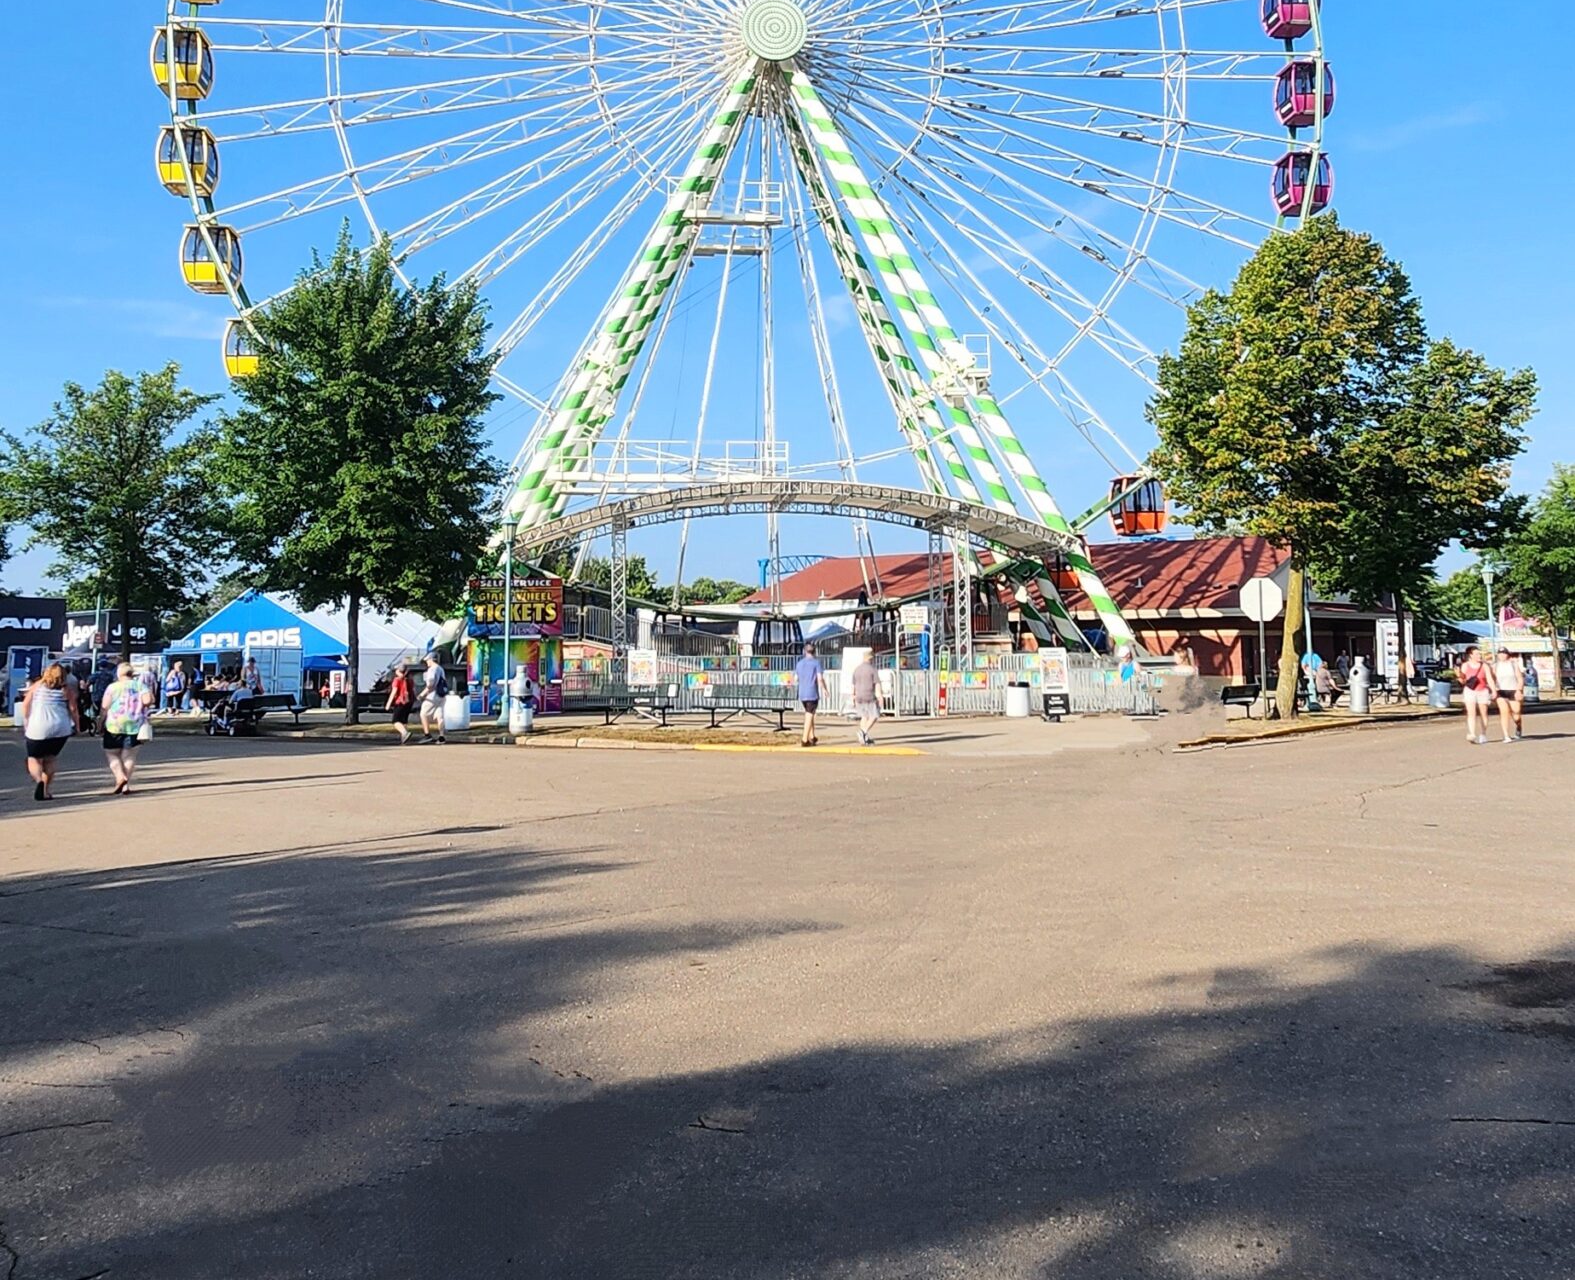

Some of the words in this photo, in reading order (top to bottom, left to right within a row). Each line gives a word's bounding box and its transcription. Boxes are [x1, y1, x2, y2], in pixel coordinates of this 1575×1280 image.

[480, 593, 510, 601] GIAN
[516, 592, 552, 601] WHEEL
[474, 604, 557, 622] TICKETS
[111, 624, 147, 639] Jep
[201, 627, 301, 648] POLARIS
